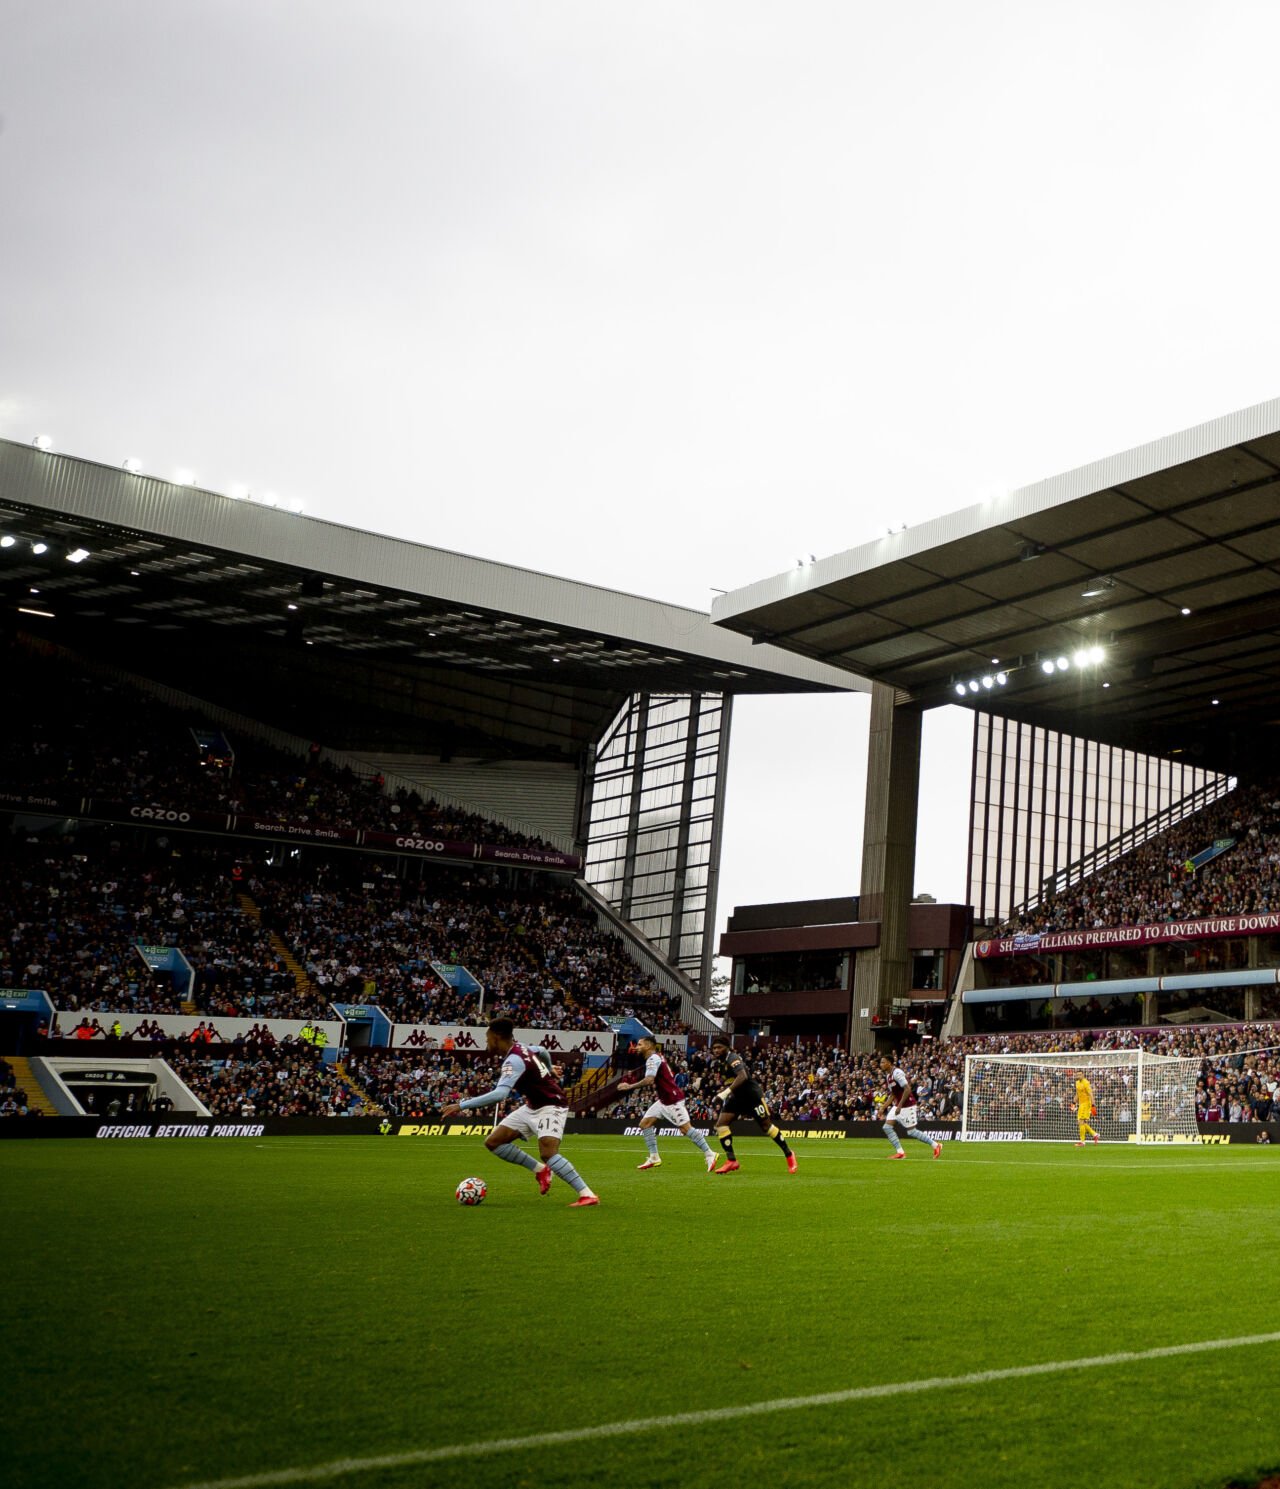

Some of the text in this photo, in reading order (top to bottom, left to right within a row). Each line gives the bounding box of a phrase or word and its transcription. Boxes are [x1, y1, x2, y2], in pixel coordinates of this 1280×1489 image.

[130, 806, 191, 823] CAZOO
[395, 837, 445, 852] CAZOO
[1000, 941, 1014, 953] SH
[1041, 933, 1083, 949] ILLIAMS
[1085, 930, 1142, 945] PREPARED
[1144, 926, 1160, 939] TO
[1162, 918, 1236, 937] ADVENTURE
[1239, 915, 1280, 930] DOWN
[400, 1125, 445, 1136] PARI
[538, 1118, 550, 1130] 41
[96, 1125, 265, 1138] OFFICIAL BETTING PARTNER
